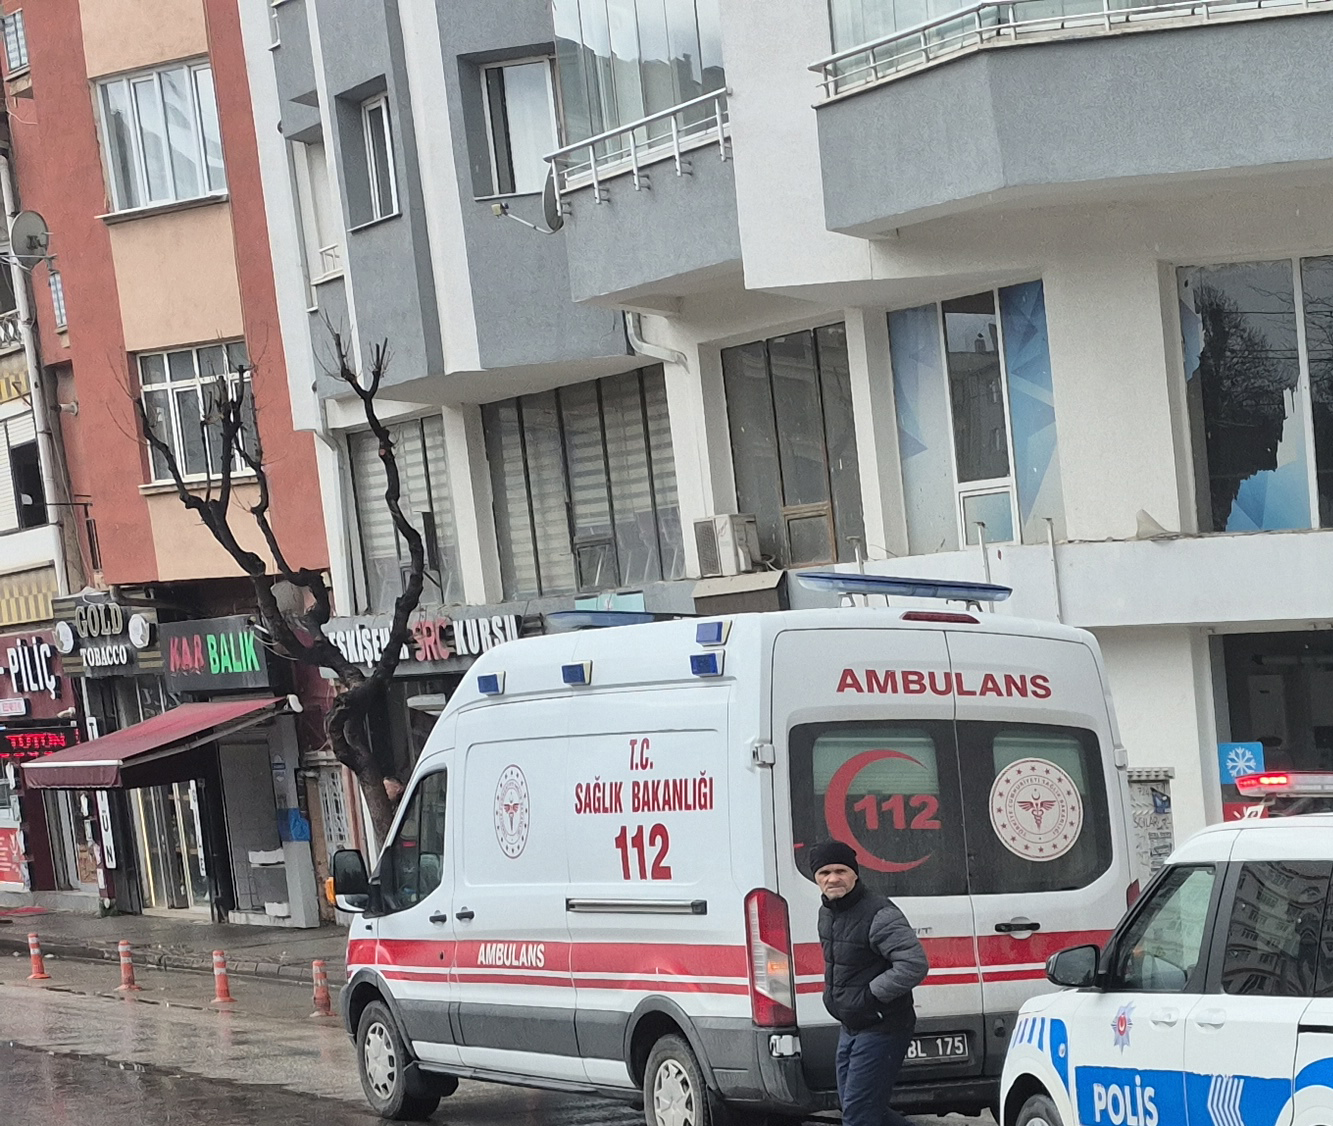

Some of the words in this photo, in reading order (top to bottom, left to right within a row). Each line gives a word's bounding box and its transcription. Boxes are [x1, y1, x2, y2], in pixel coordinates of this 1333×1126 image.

[75, 602, 123, 638] GOLD
[6, 636, 56, 700] PİLİÇ
[80, 645, 128, 667] TOBACCO
[206, 630, 260, 675] BALIK
[836, 668, 1052, 699] AMBULANS
[629, 737, 654, 770] T.C.
[574, 775, 623, 815] SAĞLIK
[631, 770, 714, 813] BAKANLIĞI
[853, 794, 942, 830] 112
[614, 823, 672, 880] 112
[477, 943, 545, 968] AMBULANS
[905, 1039, 928, 1059] BL
[935, 1036, 964, 1056] 175
